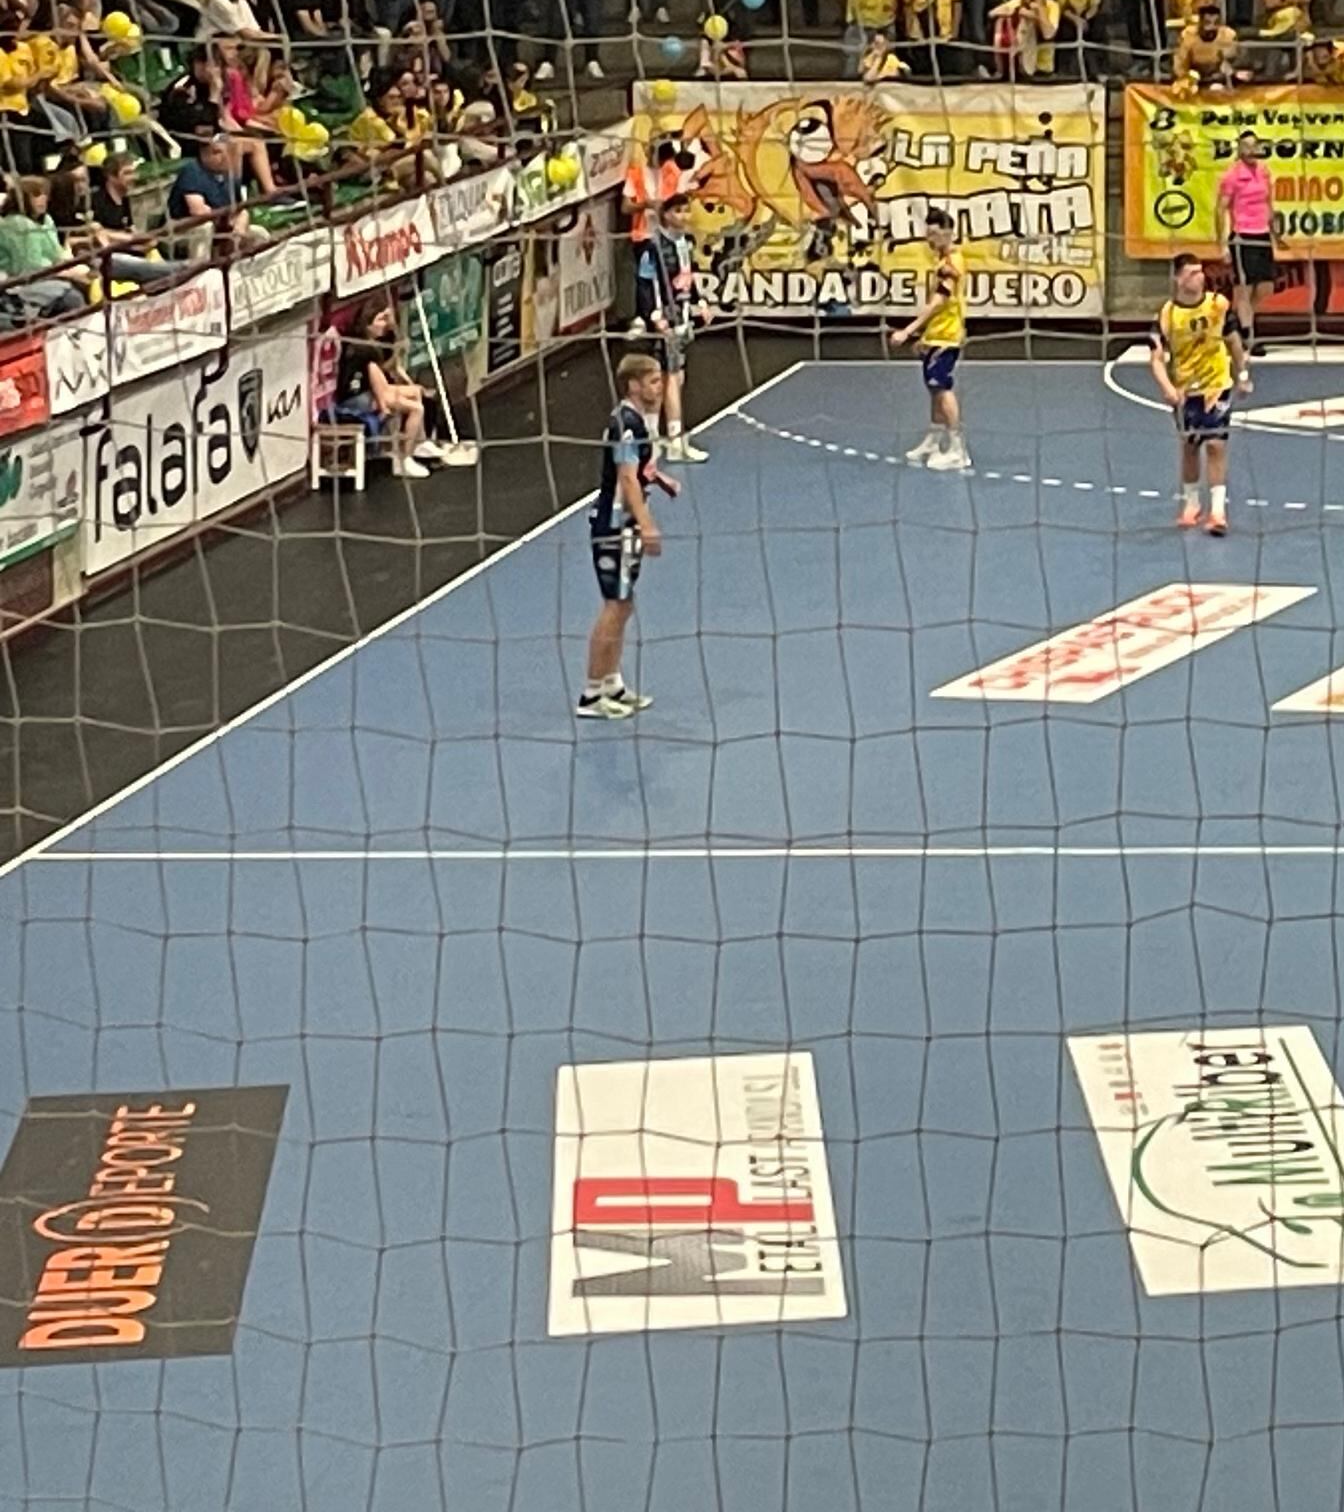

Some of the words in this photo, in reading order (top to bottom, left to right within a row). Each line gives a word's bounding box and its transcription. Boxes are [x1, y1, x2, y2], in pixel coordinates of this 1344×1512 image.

[893, 130, 953, 169] LA
[696, 270, 849, 308] RANDA
[861, 270, 918, 308] DE
[927, 270, 1086, 308] UERO
[18, 1239, 171, 1350] DUERO
